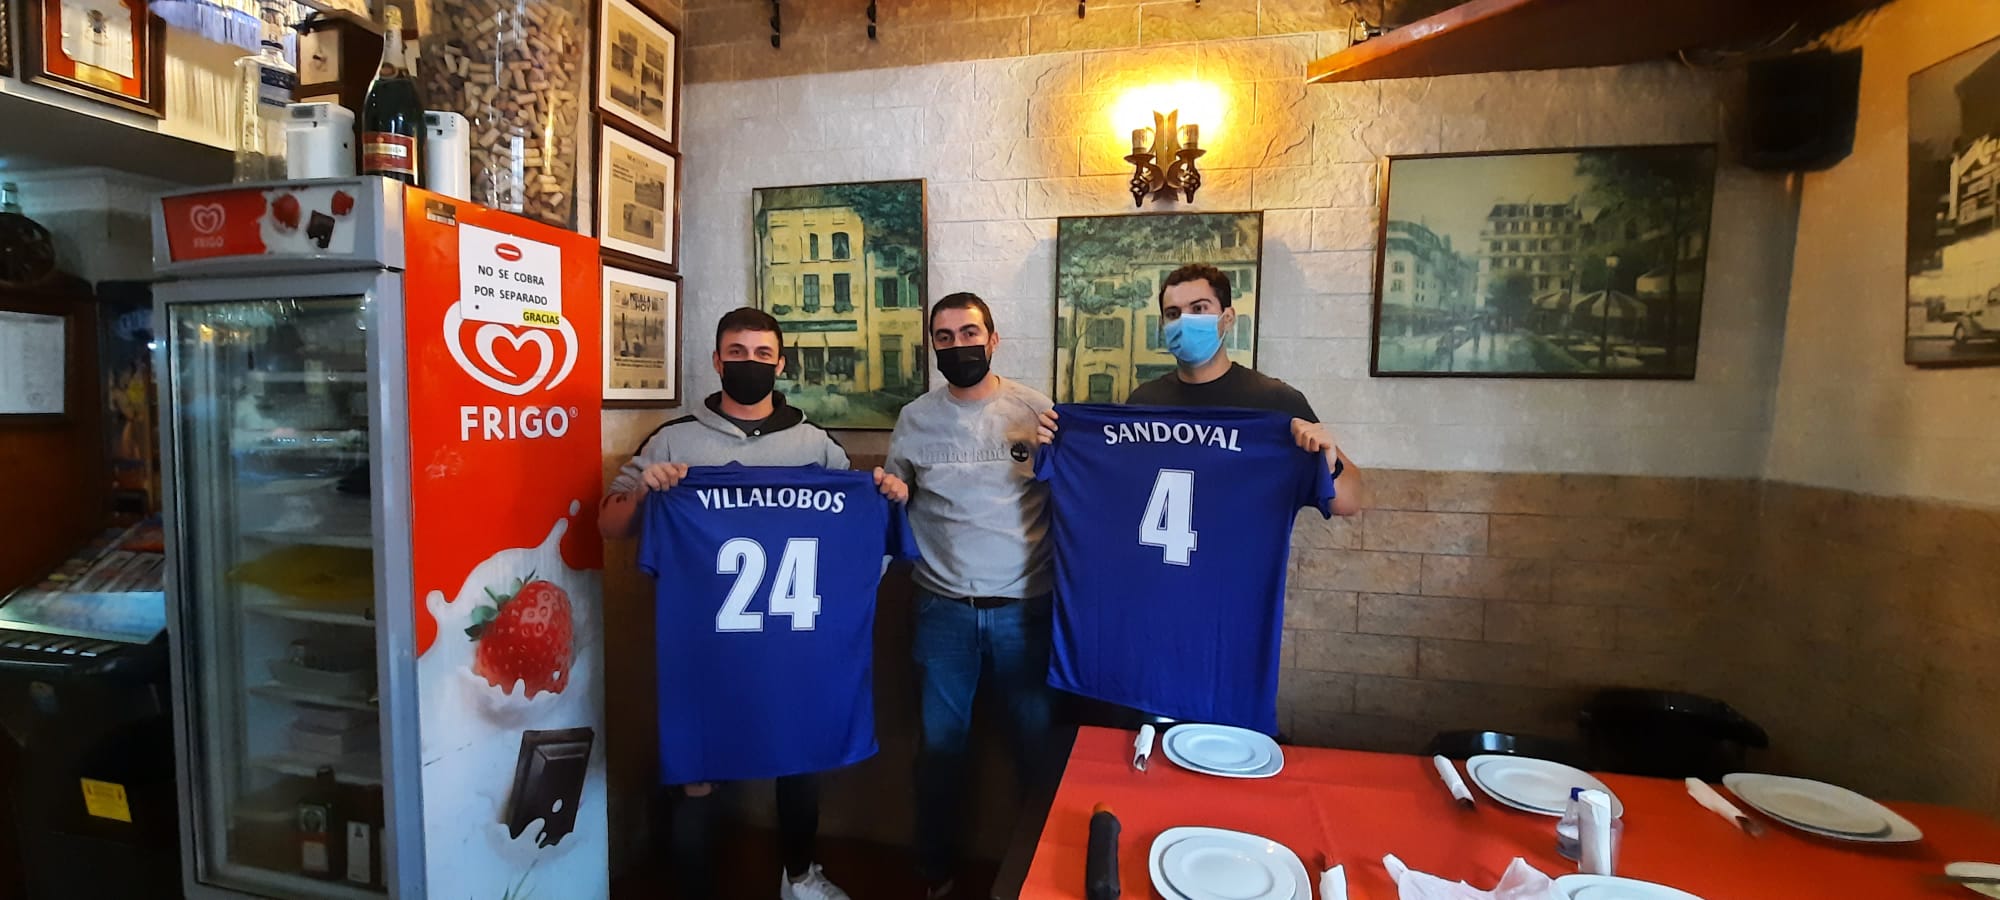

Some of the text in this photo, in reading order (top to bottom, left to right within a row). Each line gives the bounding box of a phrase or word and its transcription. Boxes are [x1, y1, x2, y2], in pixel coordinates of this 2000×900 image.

[478, 265, 545, 286] NO SE COBRA
[474, 285, 548, 306] POR SEPARADO
[523, 311, 560, 325] GRACIAS
[460, 405, 569, 441] FRIGO
[1103, 422, 1243, 453] SANDOVAL
[696, 487, 847, 514] VILLALOBOS
[1138, 468, 1198, 567] 4
[715, 537, 822, 633] 24
